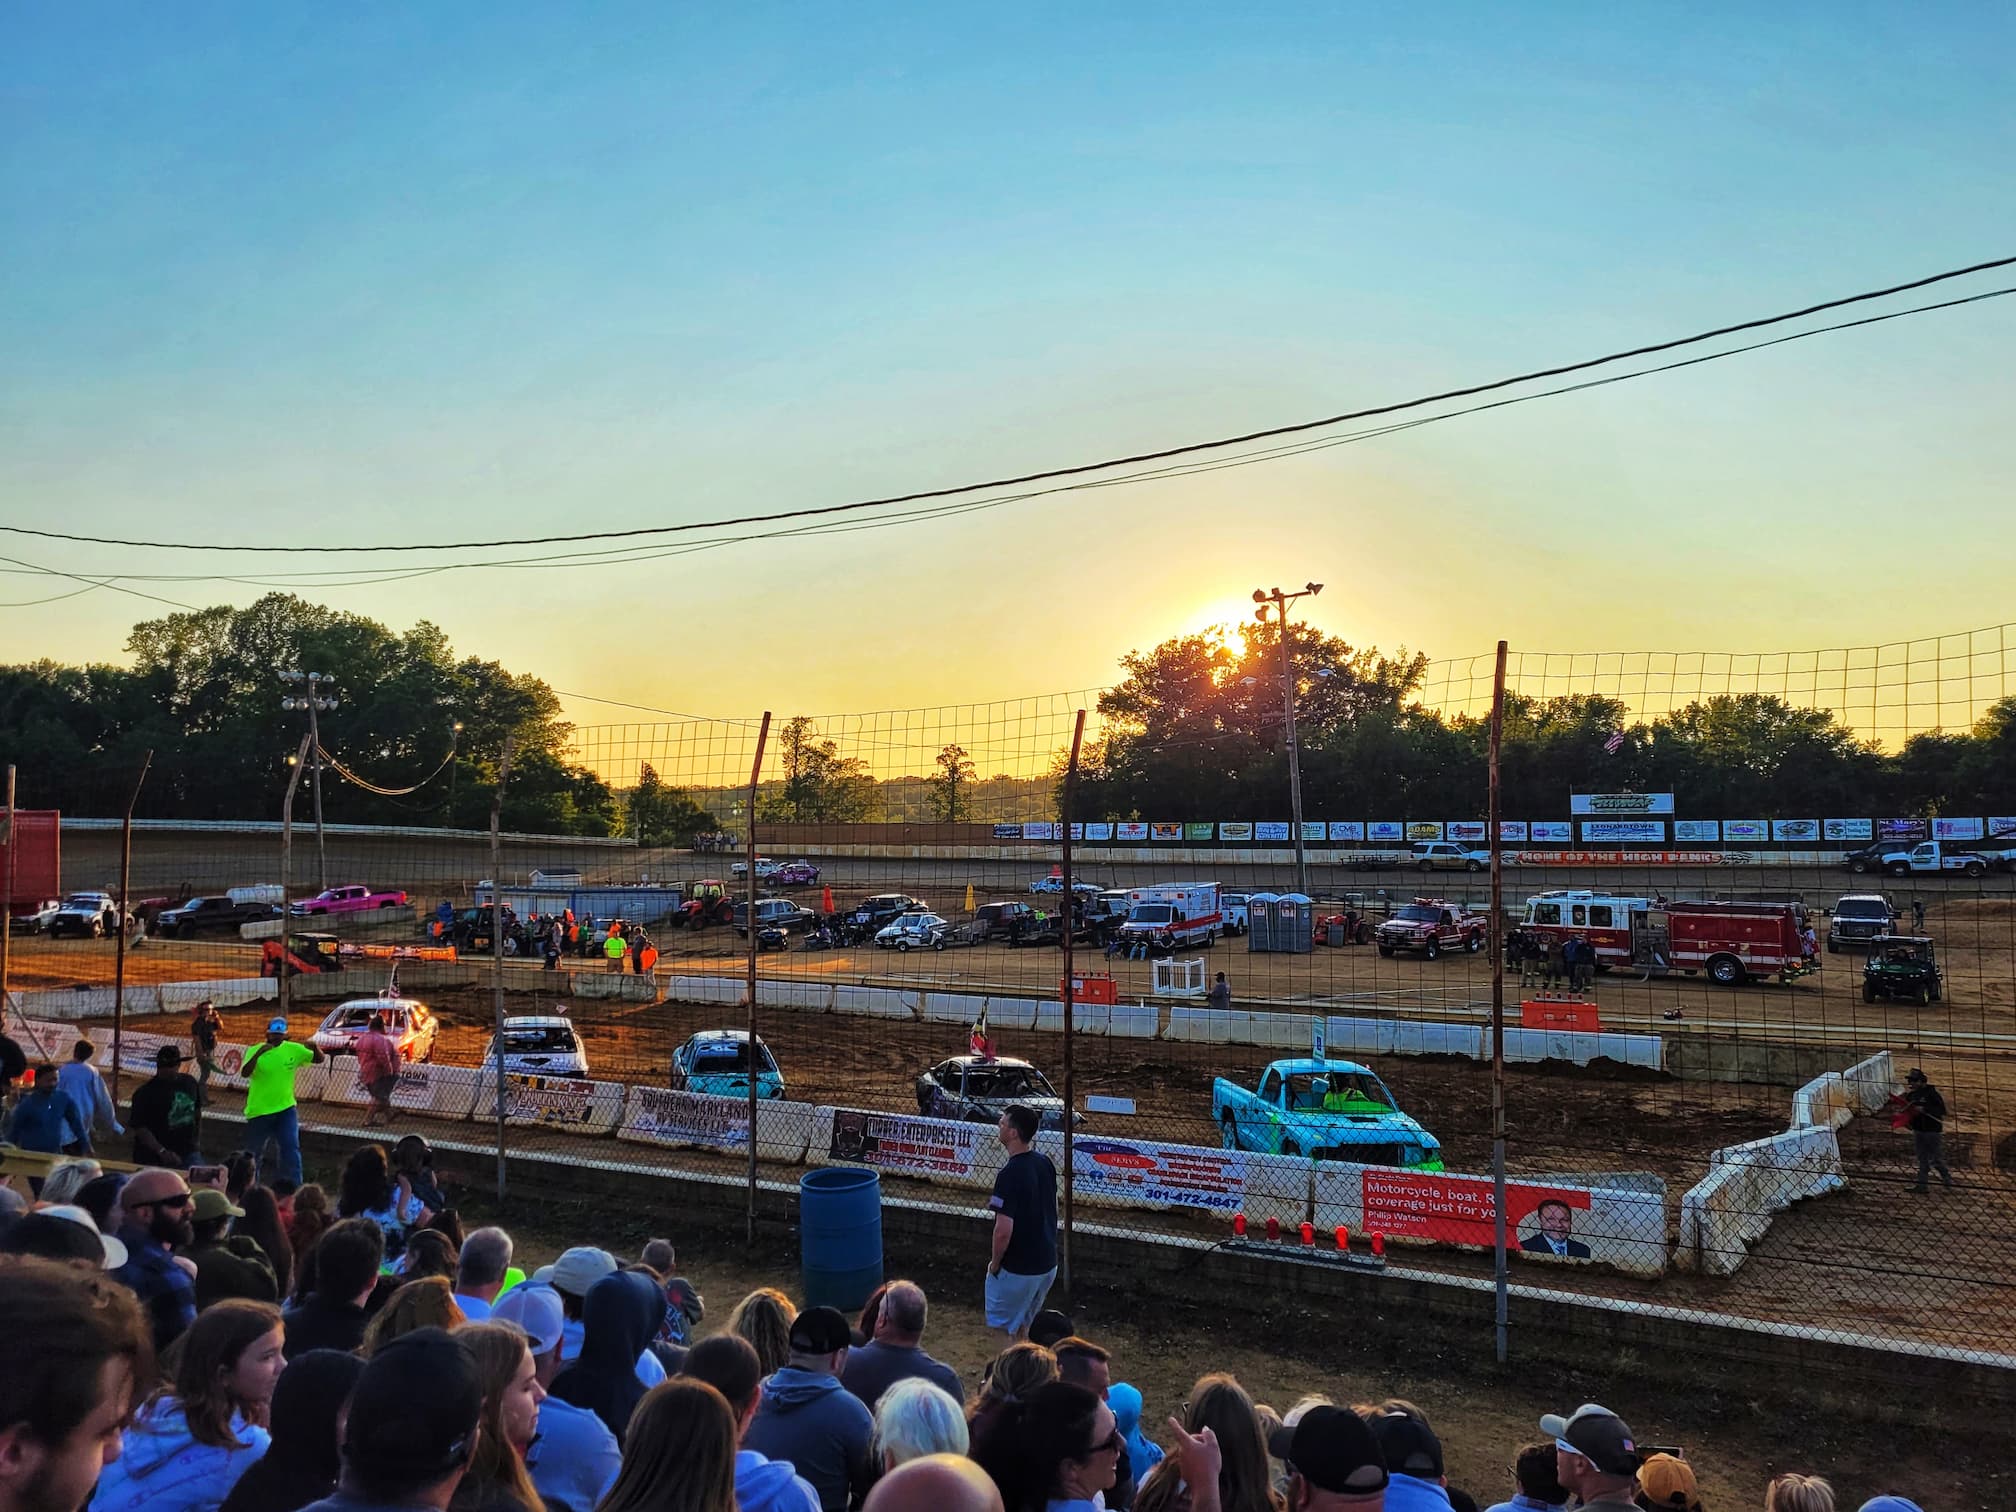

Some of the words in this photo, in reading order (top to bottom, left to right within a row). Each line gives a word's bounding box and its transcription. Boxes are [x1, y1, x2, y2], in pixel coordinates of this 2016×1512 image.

[1408, 825, 1441, 833] ADAMS
[1522, 851, 1562, 863] HOME
[1565, 851, 1584, 863] OF
[1587, 852, 1617, 863] THE
[1622, 852, 1663, 863] HIGH
[1668, 852, 1722, 864] BANKS
[642, 1092, 689, 1115] SOUTHERN
[693, 1099, 748, 1120] MARYLAND
[671, 1114, 708, 1131] SERVICES
[902, 1121, 956, 1146] ENTERPRISES
[957, 1128, 973, 1148] LLC
[1367, 1182, 1444, 1199] Motorcycle,
[1448, 1189, 1482, 1203] boat,
[1367, 1197, 1426, 1211] coverage
[1428, 1200, 1454, 1212] just
[1457, 1203, 1478, 1215] for
[1480, 1208, 1510, 1219] yo.
[1393, 1212, 1427, 1223] Watson
